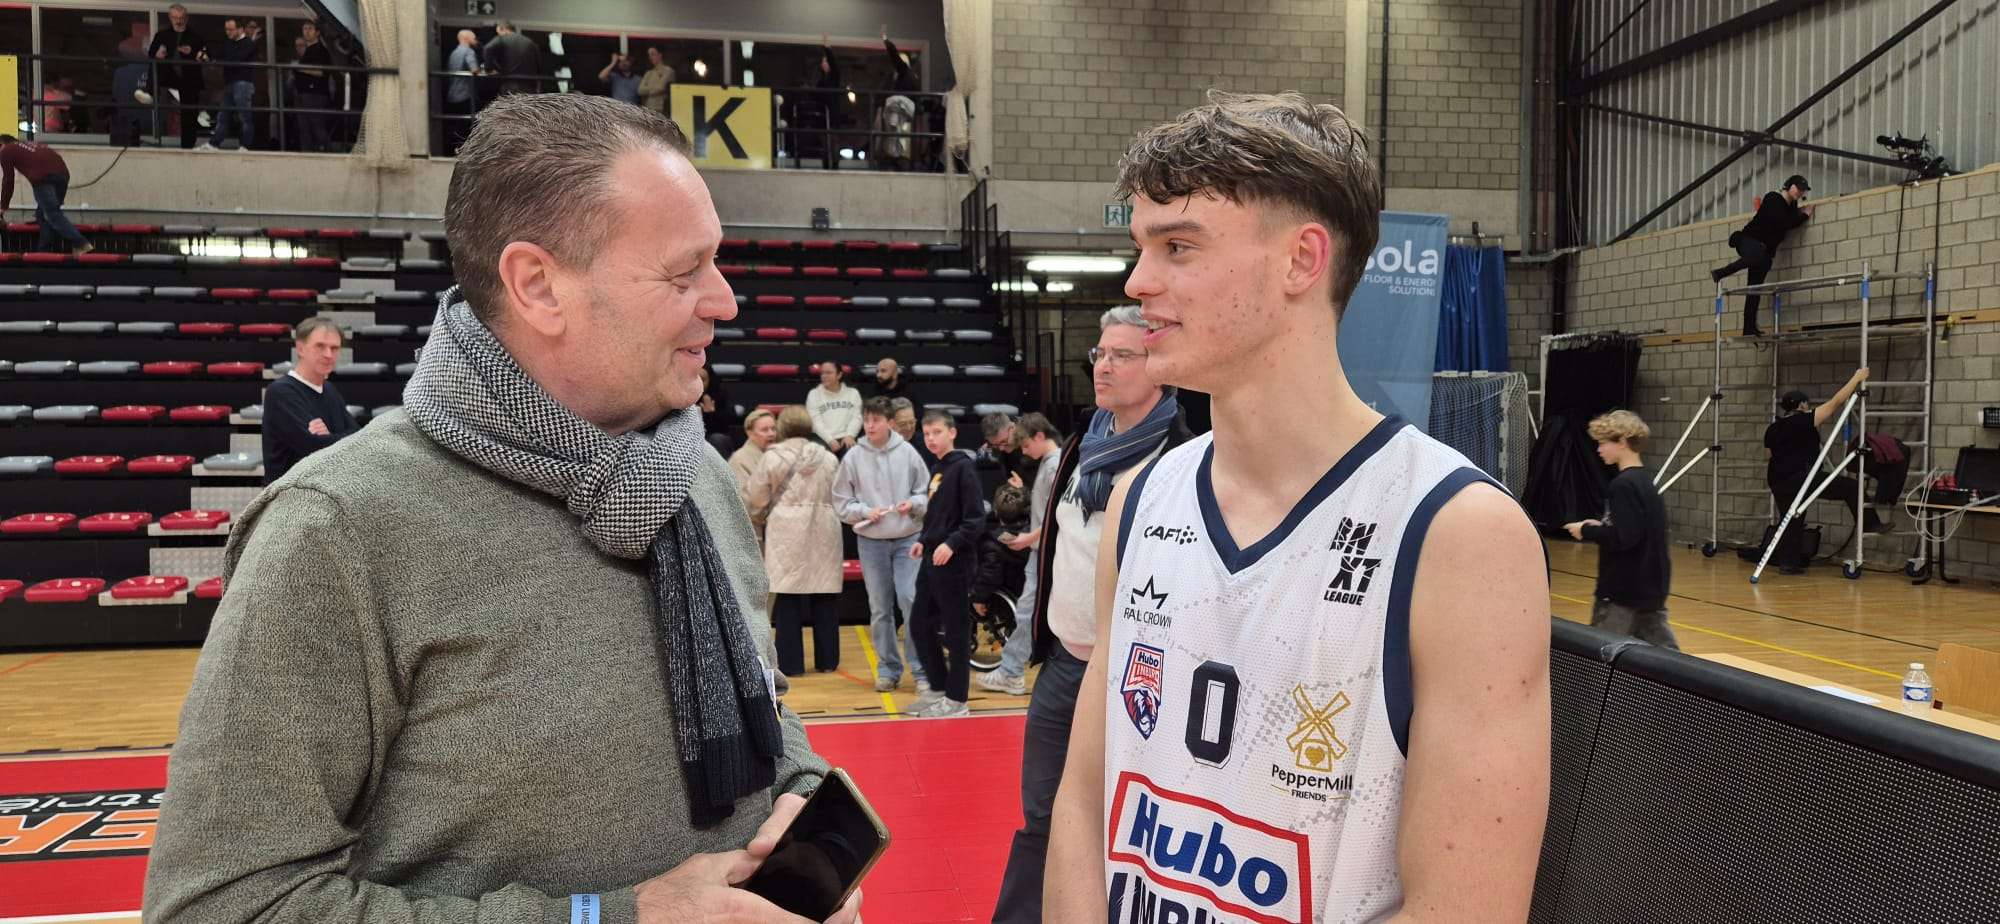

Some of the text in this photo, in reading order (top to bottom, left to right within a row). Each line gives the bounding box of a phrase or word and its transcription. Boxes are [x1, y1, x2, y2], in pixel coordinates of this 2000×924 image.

[693, 96, 749, 160] K
[1324, 590, 1365, 605] LEAGUE
[1138, 652, 1159, 667] Hubo
[1185, 660, 1241, 768] 0
[1271, 764, 1353, 791] PepperMill
[1291, 789, 1327, 802] FRIENDS
[1129, 792, 1288, 907] Hubo
